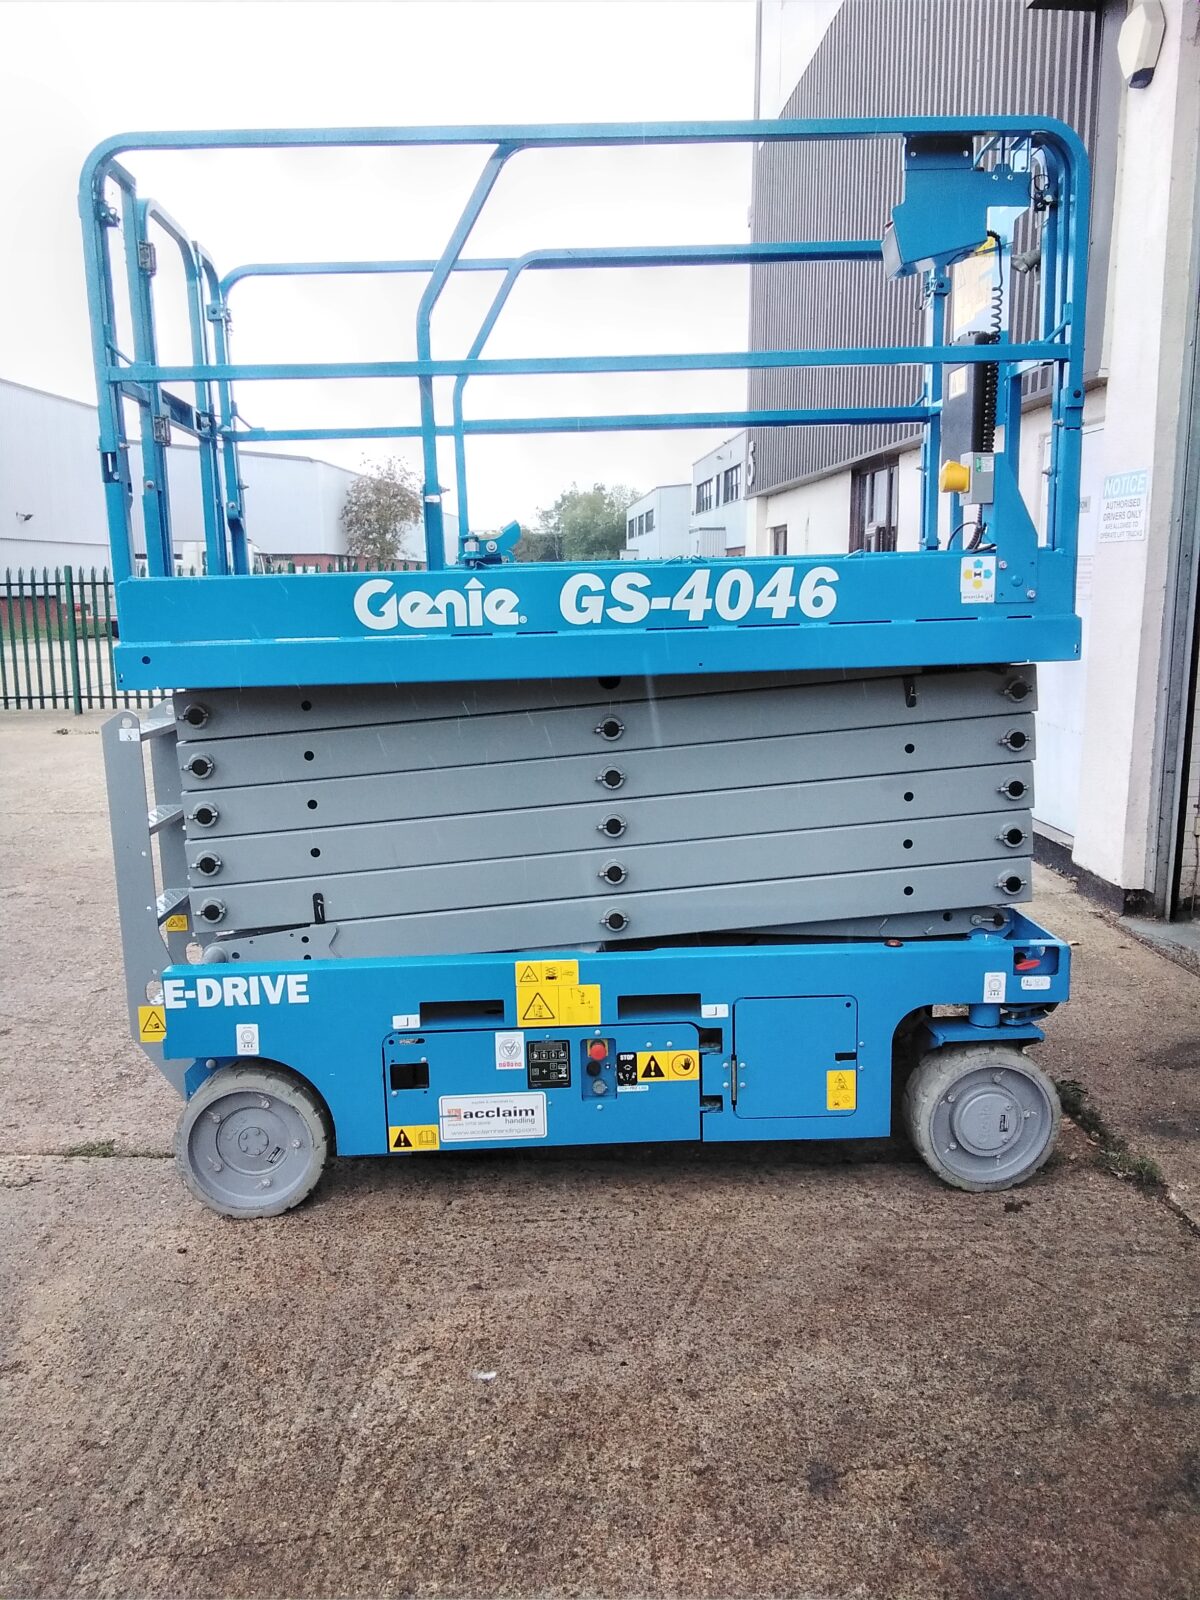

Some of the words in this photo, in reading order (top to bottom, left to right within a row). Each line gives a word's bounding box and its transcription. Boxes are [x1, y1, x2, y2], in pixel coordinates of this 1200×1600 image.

[1104, 474, 1147, 498] NOTICE
[1106, 498, 1141, 510] AUTHORISED
[1103, 511, 1126, 521] DRIVERS
[1127, 509, 1142, 519] ONLY
[1113, 521, 1132, 529] ALLOWED
[1126, 529, 1143, 537] TRUCKS
[353, 577, 520, 630] Genie
[559, 566, 840, 627] GS-4046
[163, 974, 310, 1009] E-DRIVE
[463, 1106, 535, 1119] acclaim
[504, 1117, 536, 1125] handling
